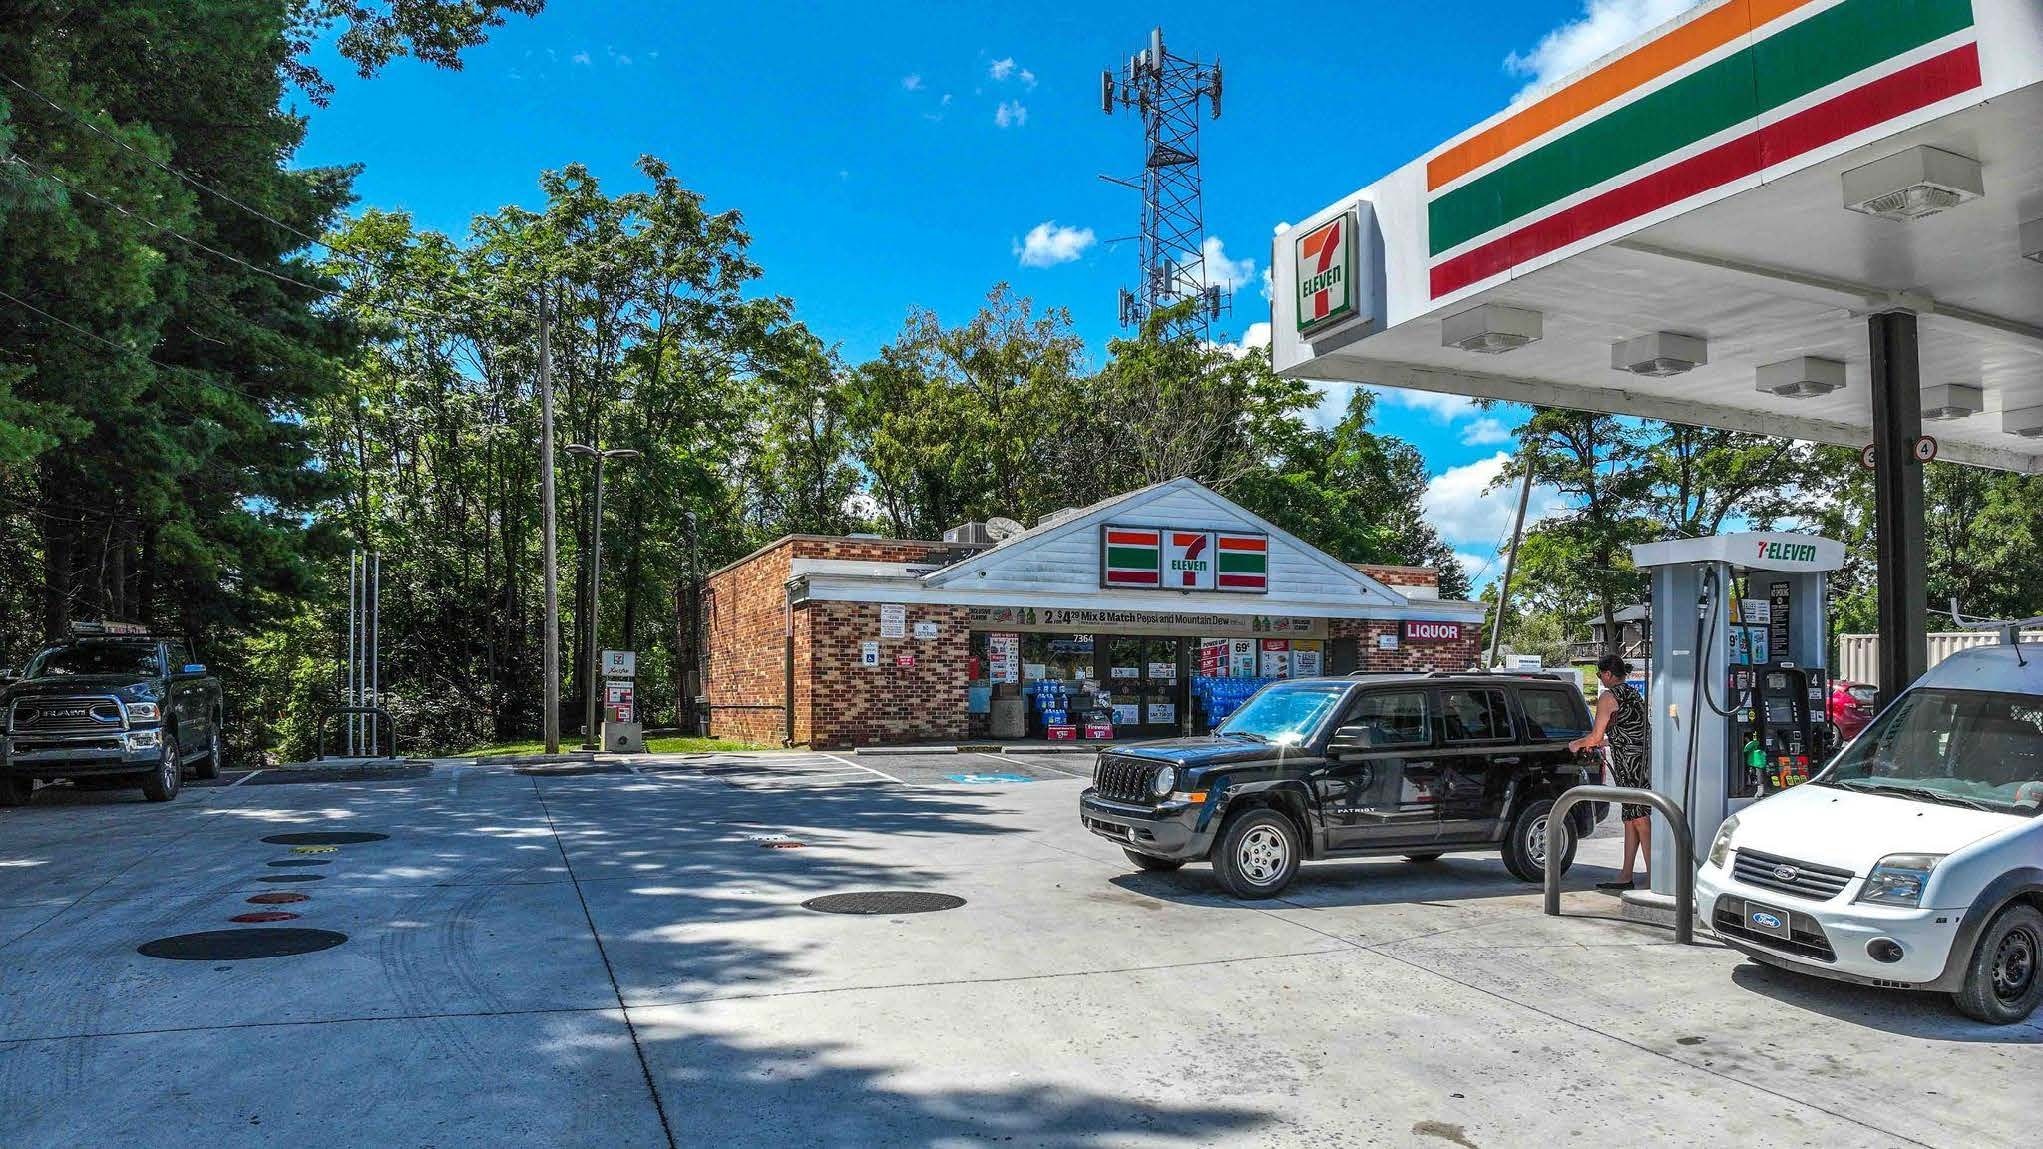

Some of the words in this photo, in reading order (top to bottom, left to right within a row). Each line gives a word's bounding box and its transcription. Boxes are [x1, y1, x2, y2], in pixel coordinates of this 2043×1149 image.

[1304, 220, 1340, 319] 7
[1920, 443, 1929, 455] 4
[1173, 533, 1207, 586] 7
[1044, 610, 1053, 624] 2
[1081, 611, 1098, 622] Mix
[1099, 612, 1106, 622] &
[1107, 612, 1135, 623] Match
[1136, 613, 1159, 625] Pepsi
[1159, 614, 1174, 624] and
[1174, 614, 1212, 625] Mountain
[1213, 616, 1230, 625] Dew
[1073, 634, 1094, 643] 7364
[1407, 624, 1458, 639] LIQUOR
[1811, 673, 1818, 686] 4
[1758, 914, 1777, 926] Ford
